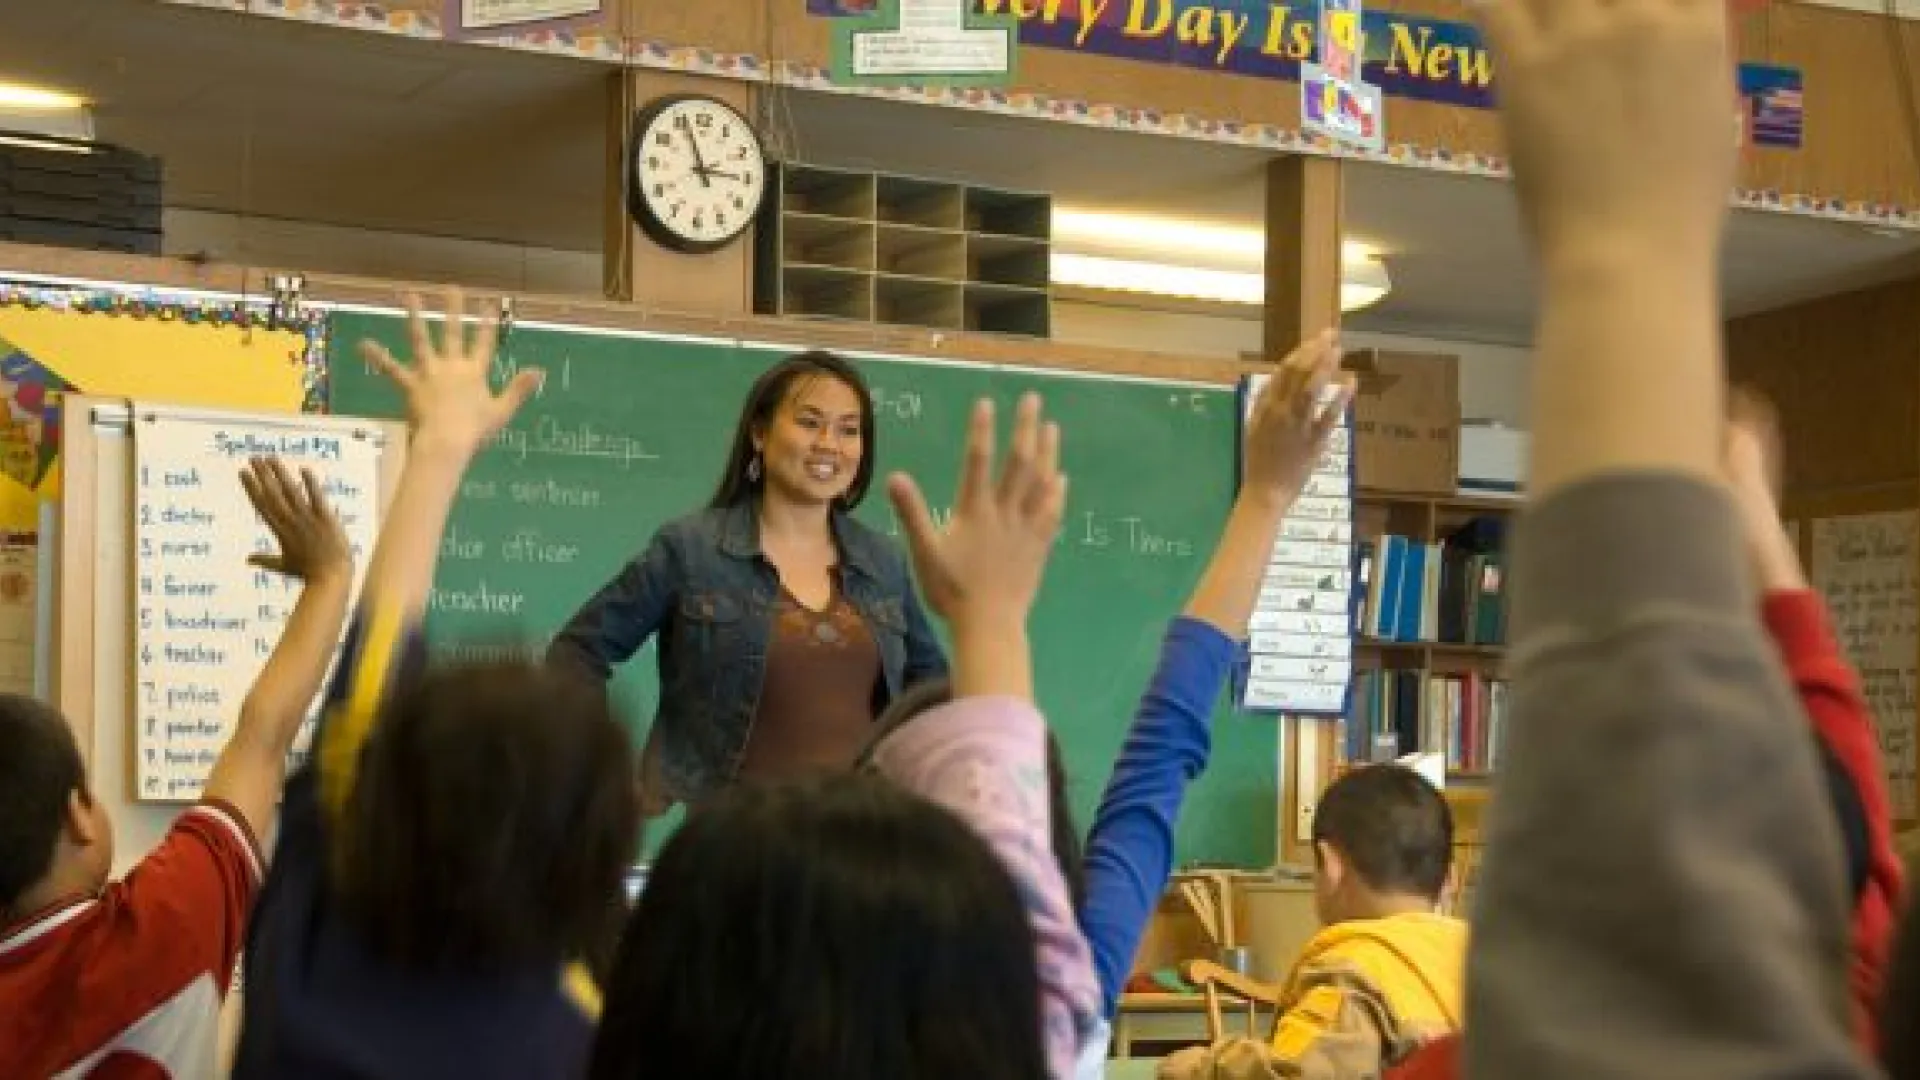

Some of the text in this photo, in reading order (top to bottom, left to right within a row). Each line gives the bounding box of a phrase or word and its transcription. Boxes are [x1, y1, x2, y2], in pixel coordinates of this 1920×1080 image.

[1122, 0, 1247, 65] Day
[1261, 4, 1312, 60] Is
[1384, 22, 1491, 88] New
[165, 467, 200, 486] cook
